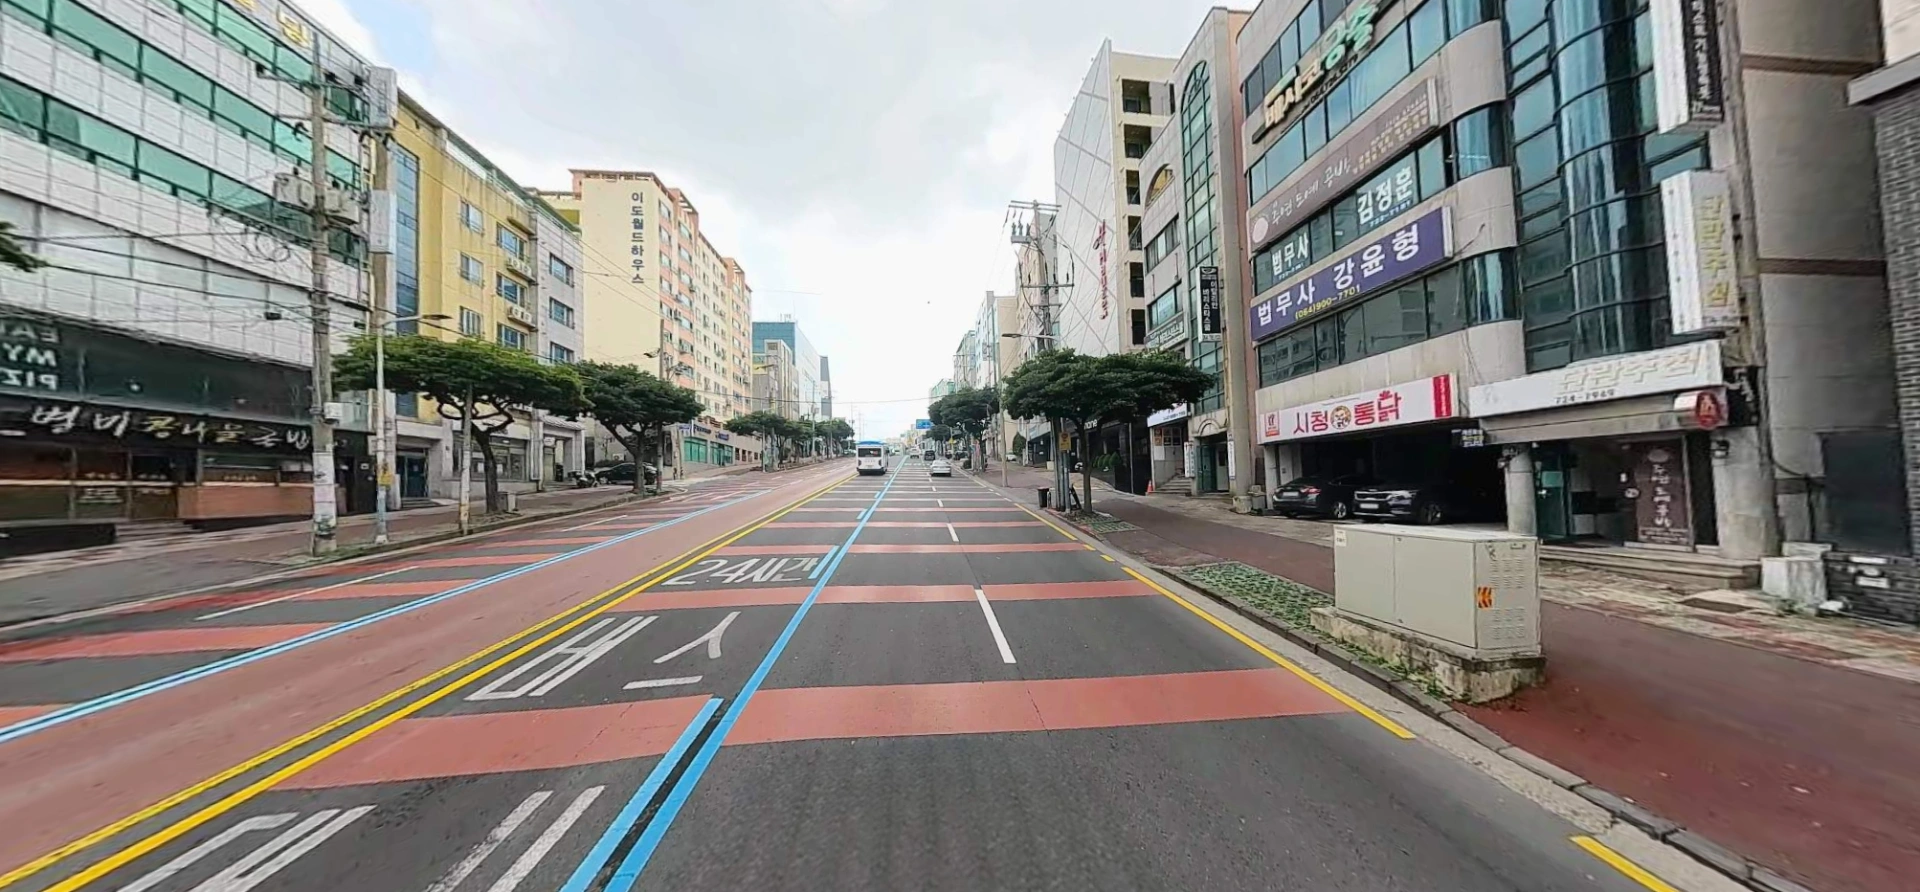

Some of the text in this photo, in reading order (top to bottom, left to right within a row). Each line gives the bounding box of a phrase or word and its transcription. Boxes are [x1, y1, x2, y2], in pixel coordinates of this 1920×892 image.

[631, 192, 644, 284] 이도월드하우스
[1271, 165, 1414, 277] 법무사 김정훈
[1257, 223, 1420, 327] 법무사 강윤형
[1293, 410, 1329, 436] 시청
[660, 556, 821, 586] 24시간
[463, 610, 742, 701] 버스
